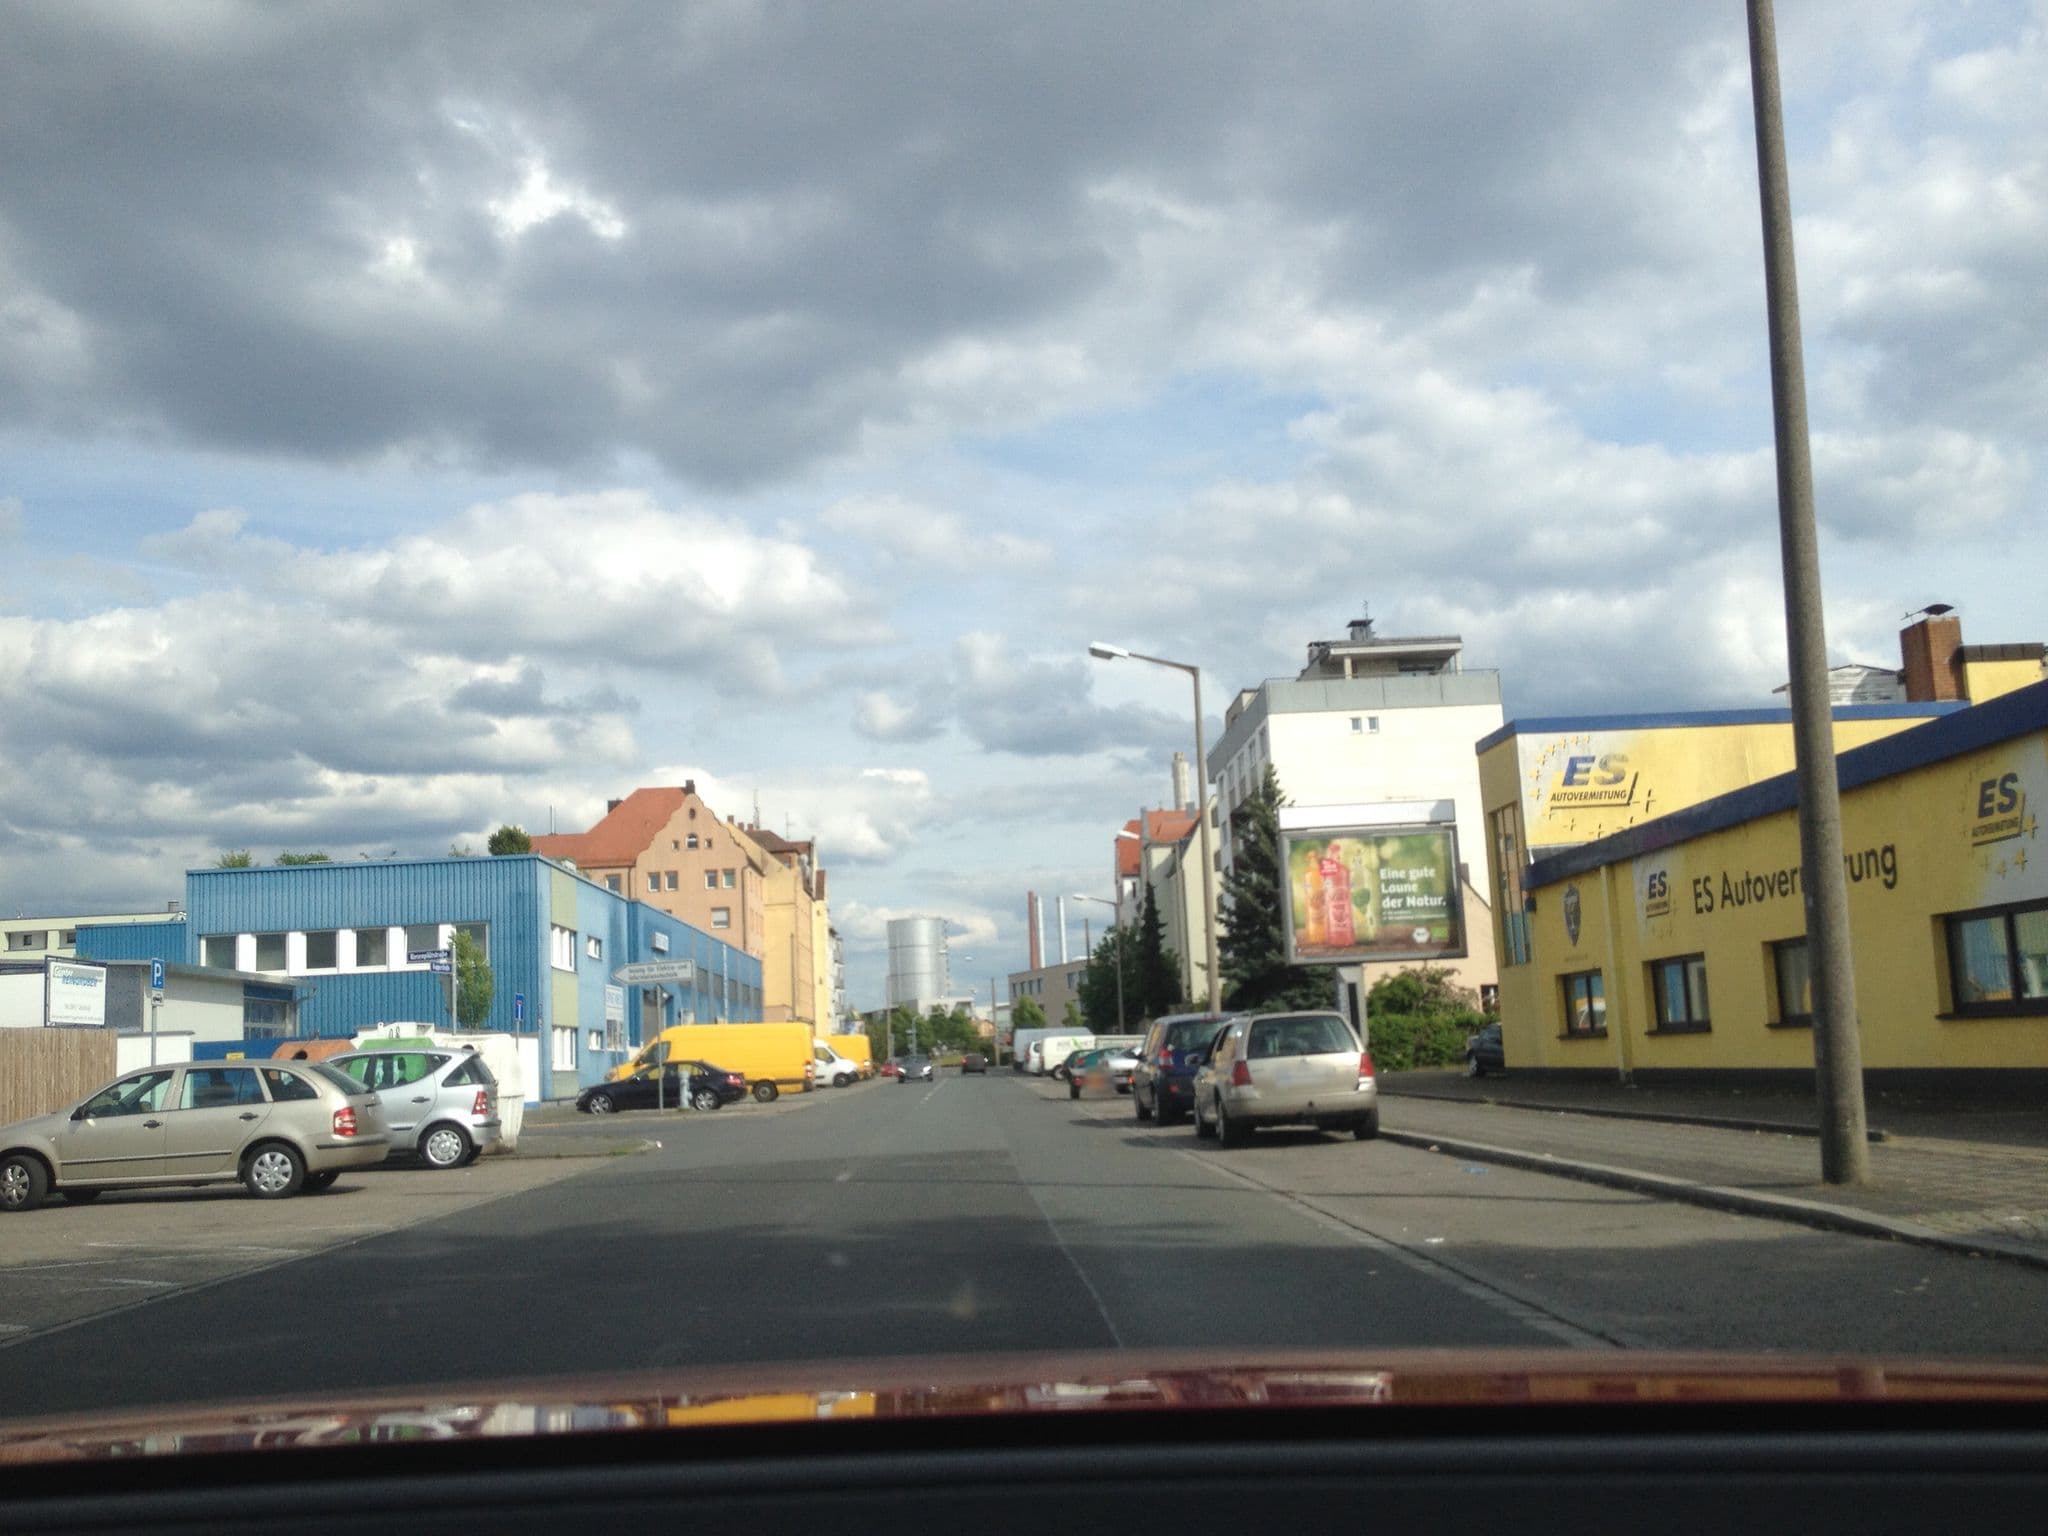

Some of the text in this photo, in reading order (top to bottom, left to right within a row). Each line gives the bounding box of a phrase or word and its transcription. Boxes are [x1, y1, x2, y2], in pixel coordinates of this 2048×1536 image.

[1562, 754, 1629, 787] ES
[1551, 790, 1627, 802] AUTOVERMIETUNG
[1978, 772, 2018, 819] ES
[1380, 866, 1436, 881] Eine gute
[1648, 870, 1667, 899] ES
[1692, 844, 1898, 914] ES Autoverung
[1381, 882, 1418, 894] Laune
[1382, 894, 1447, 909] der Natur.
